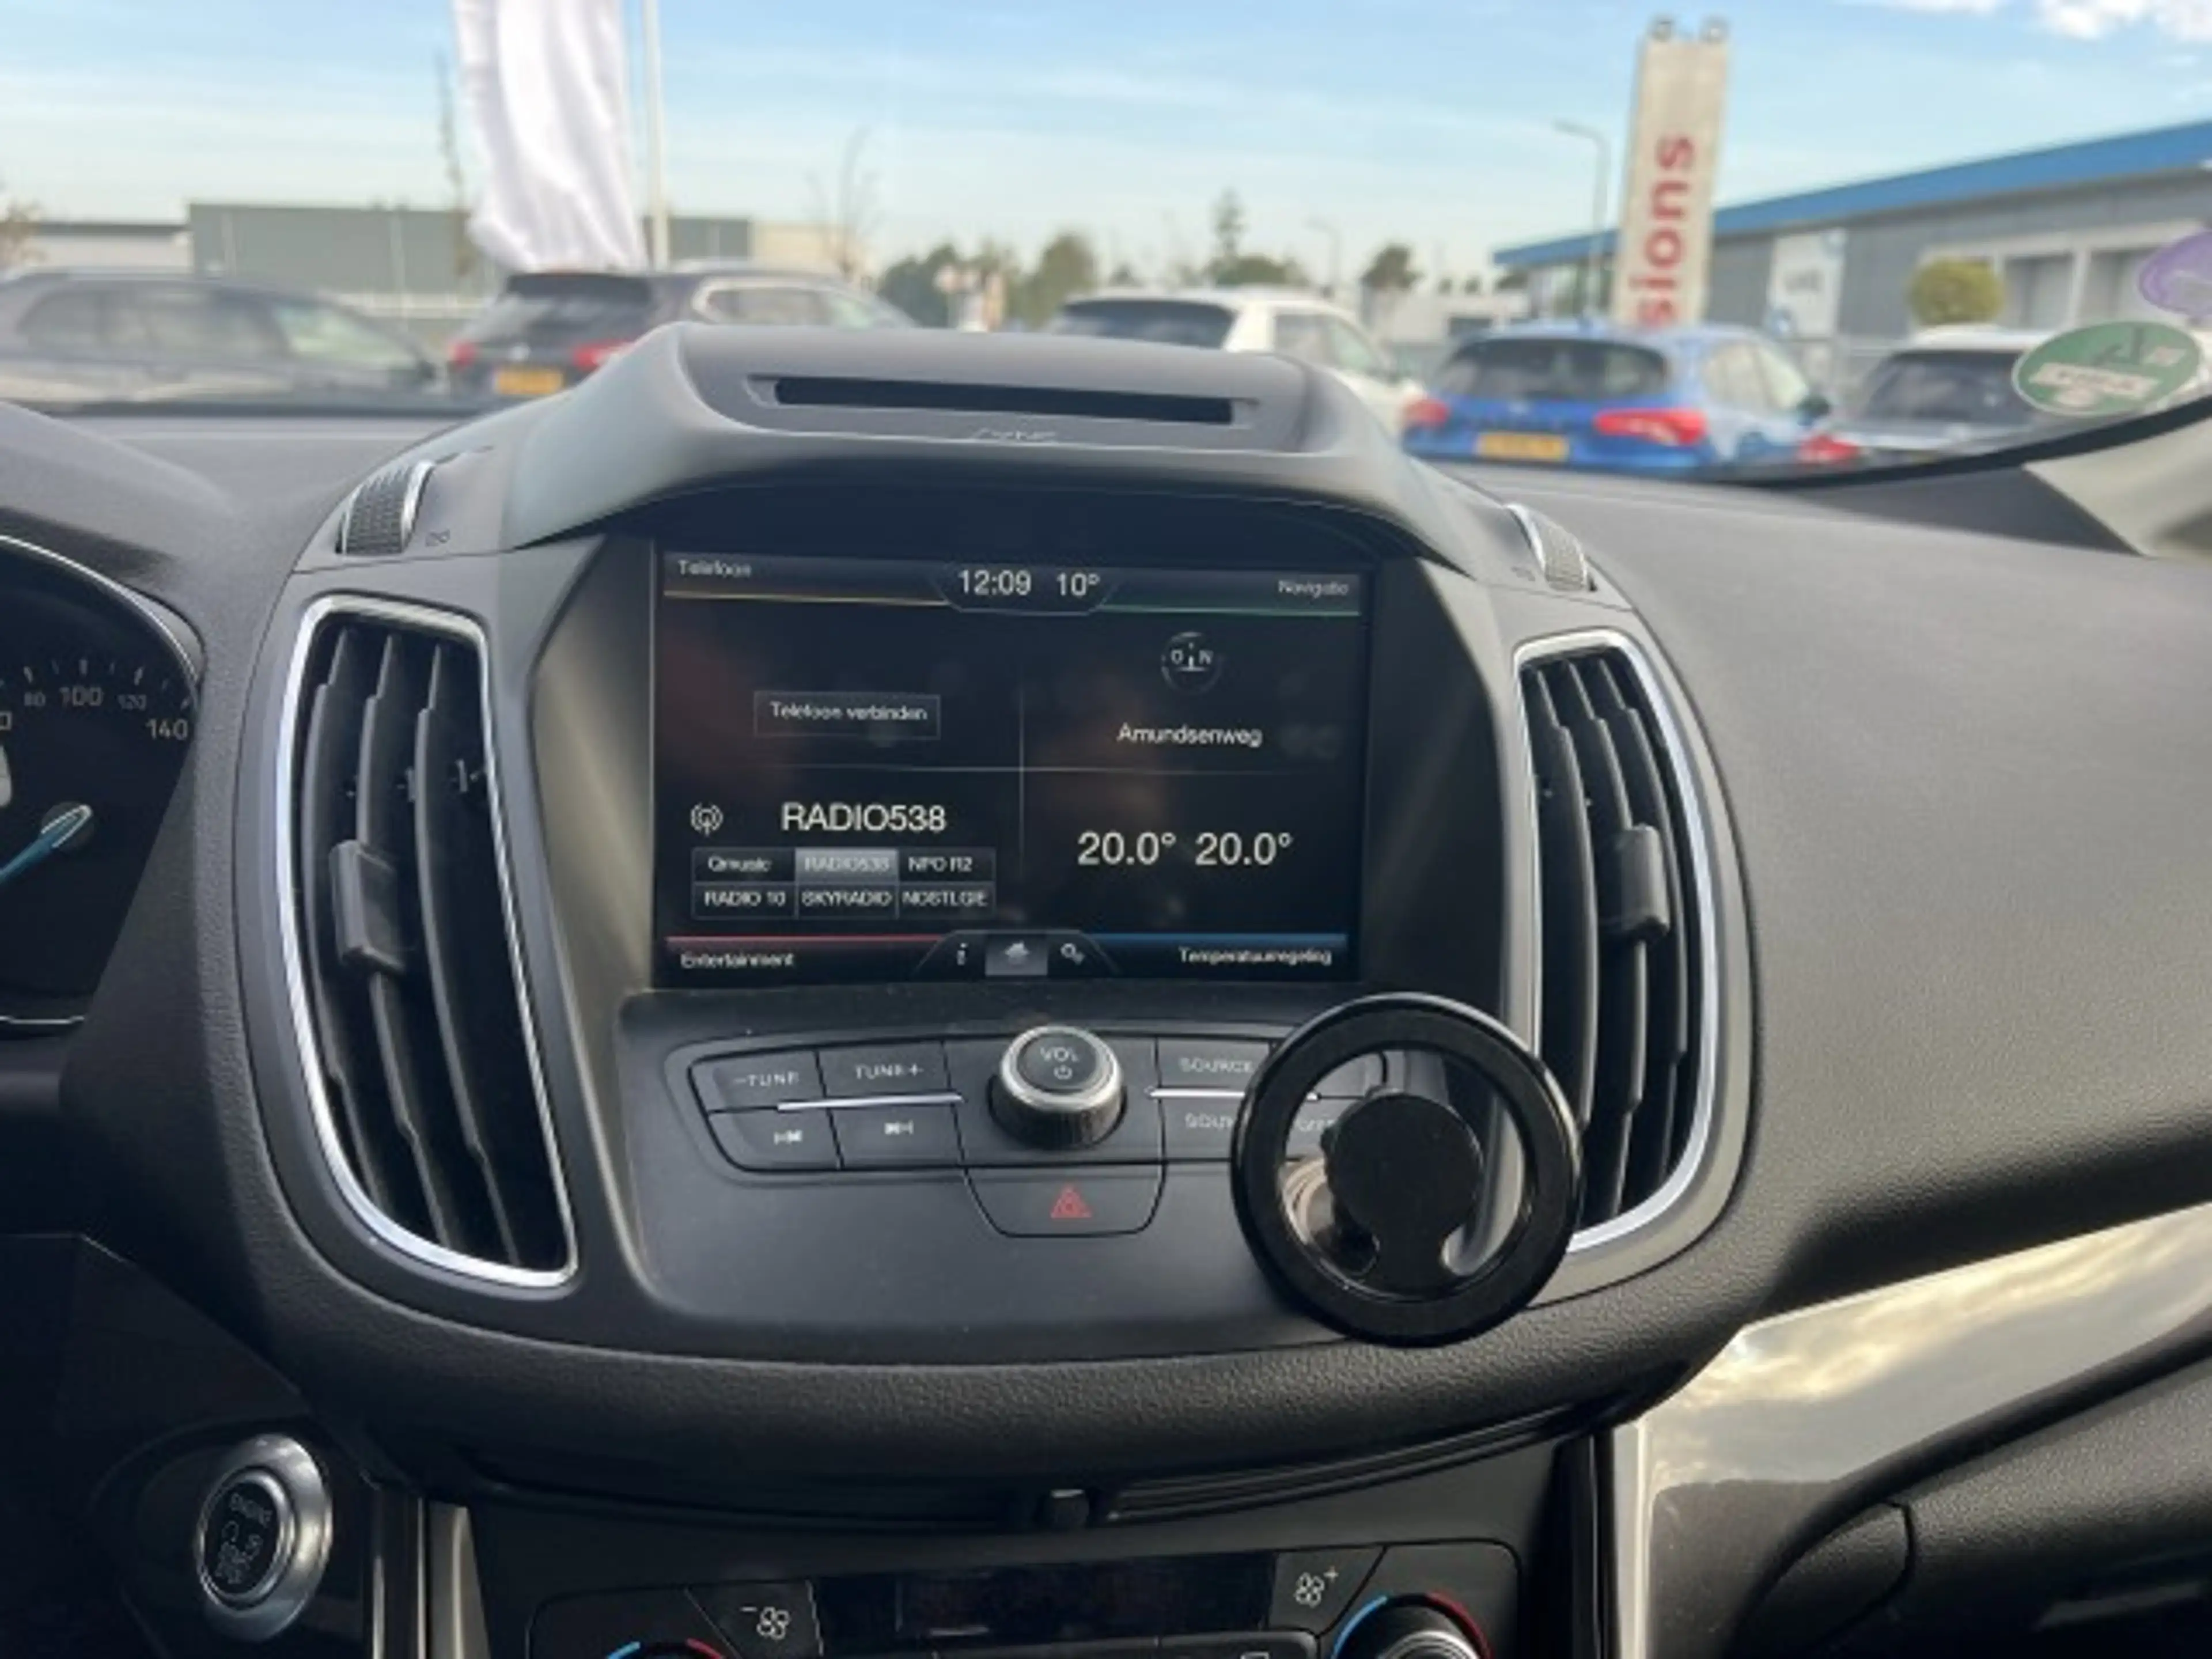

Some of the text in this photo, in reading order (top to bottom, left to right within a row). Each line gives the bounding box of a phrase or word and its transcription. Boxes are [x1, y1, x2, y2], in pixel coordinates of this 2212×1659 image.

[957, 569, 1031, 596] 12:09
[146, 718, 188, 741] 140
[781, 801, 948, 833] RADIO538
[1078, 831, 1293, 865] 20.0° 20.0°
[704, 891, 762, 907] RADIO
[1040, 1046, 1080, 1063] VOL
[1179, 1056, 1254, 1074] SOURCE
